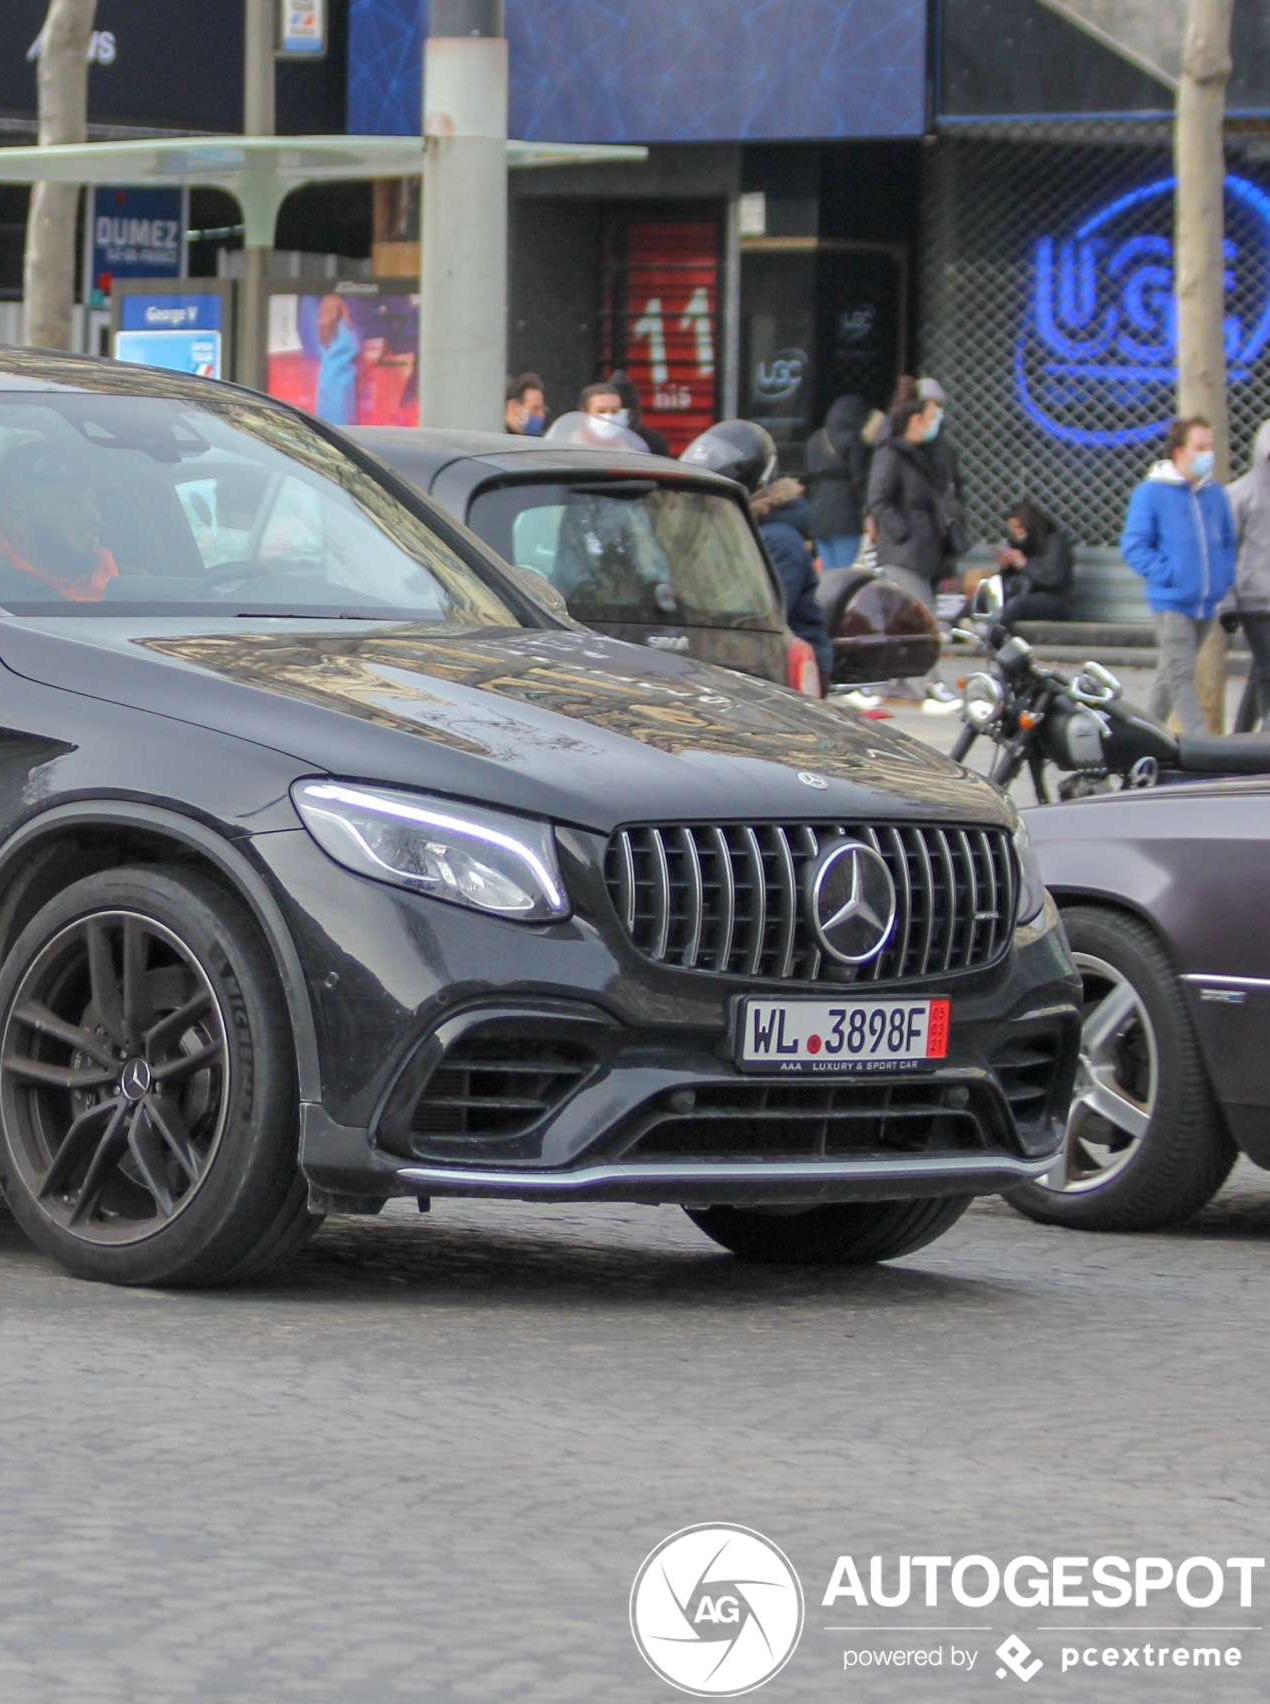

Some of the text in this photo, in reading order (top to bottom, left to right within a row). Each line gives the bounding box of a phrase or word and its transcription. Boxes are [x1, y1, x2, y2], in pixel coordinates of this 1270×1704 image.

[97, 217, 178, 248] DUMEZ
[146, 307, 198, 323] George V
[634, 287, 714, 384] 11
[758, 360, 802, 386] UGC
[933, 1007, 945, 1020] 05
[754, 1007, 926, 1054] WL 3898F
[780, 1061, 918, 1071] AAA LUXURY & SPORT CAR
